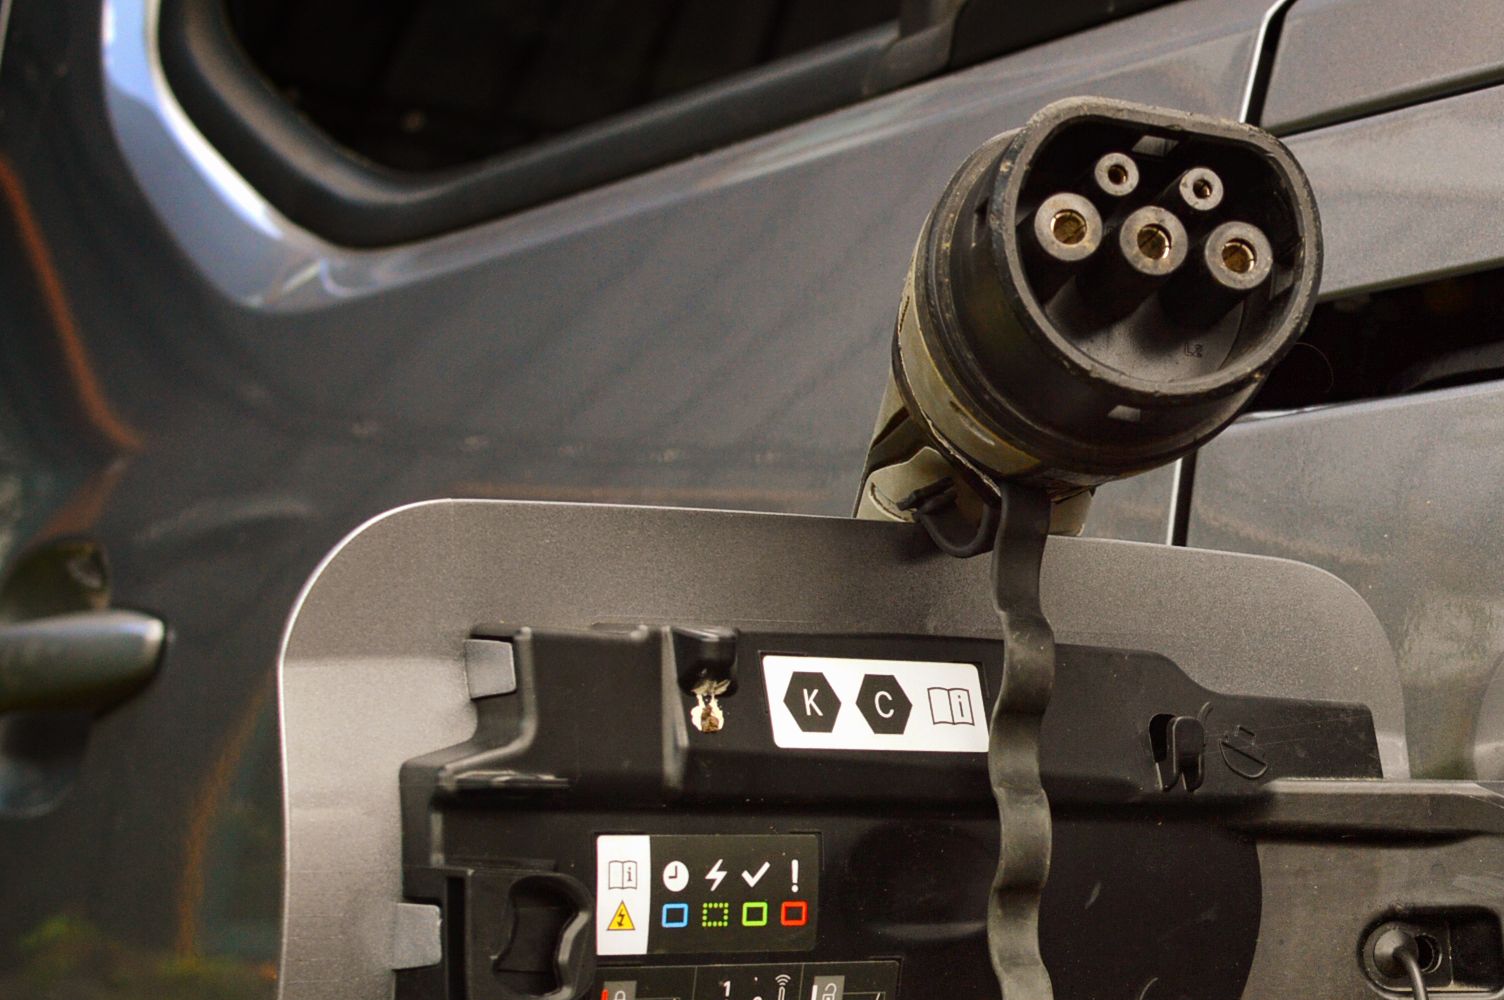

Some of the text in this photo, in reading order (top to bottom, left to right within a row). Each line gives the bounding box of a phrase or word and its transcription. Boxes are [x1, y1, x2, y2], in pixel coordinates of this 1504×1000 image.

[802, 688, 824, 717] K
[874, 690, 895, 718] C
[723, 980, 731, 997] 1
